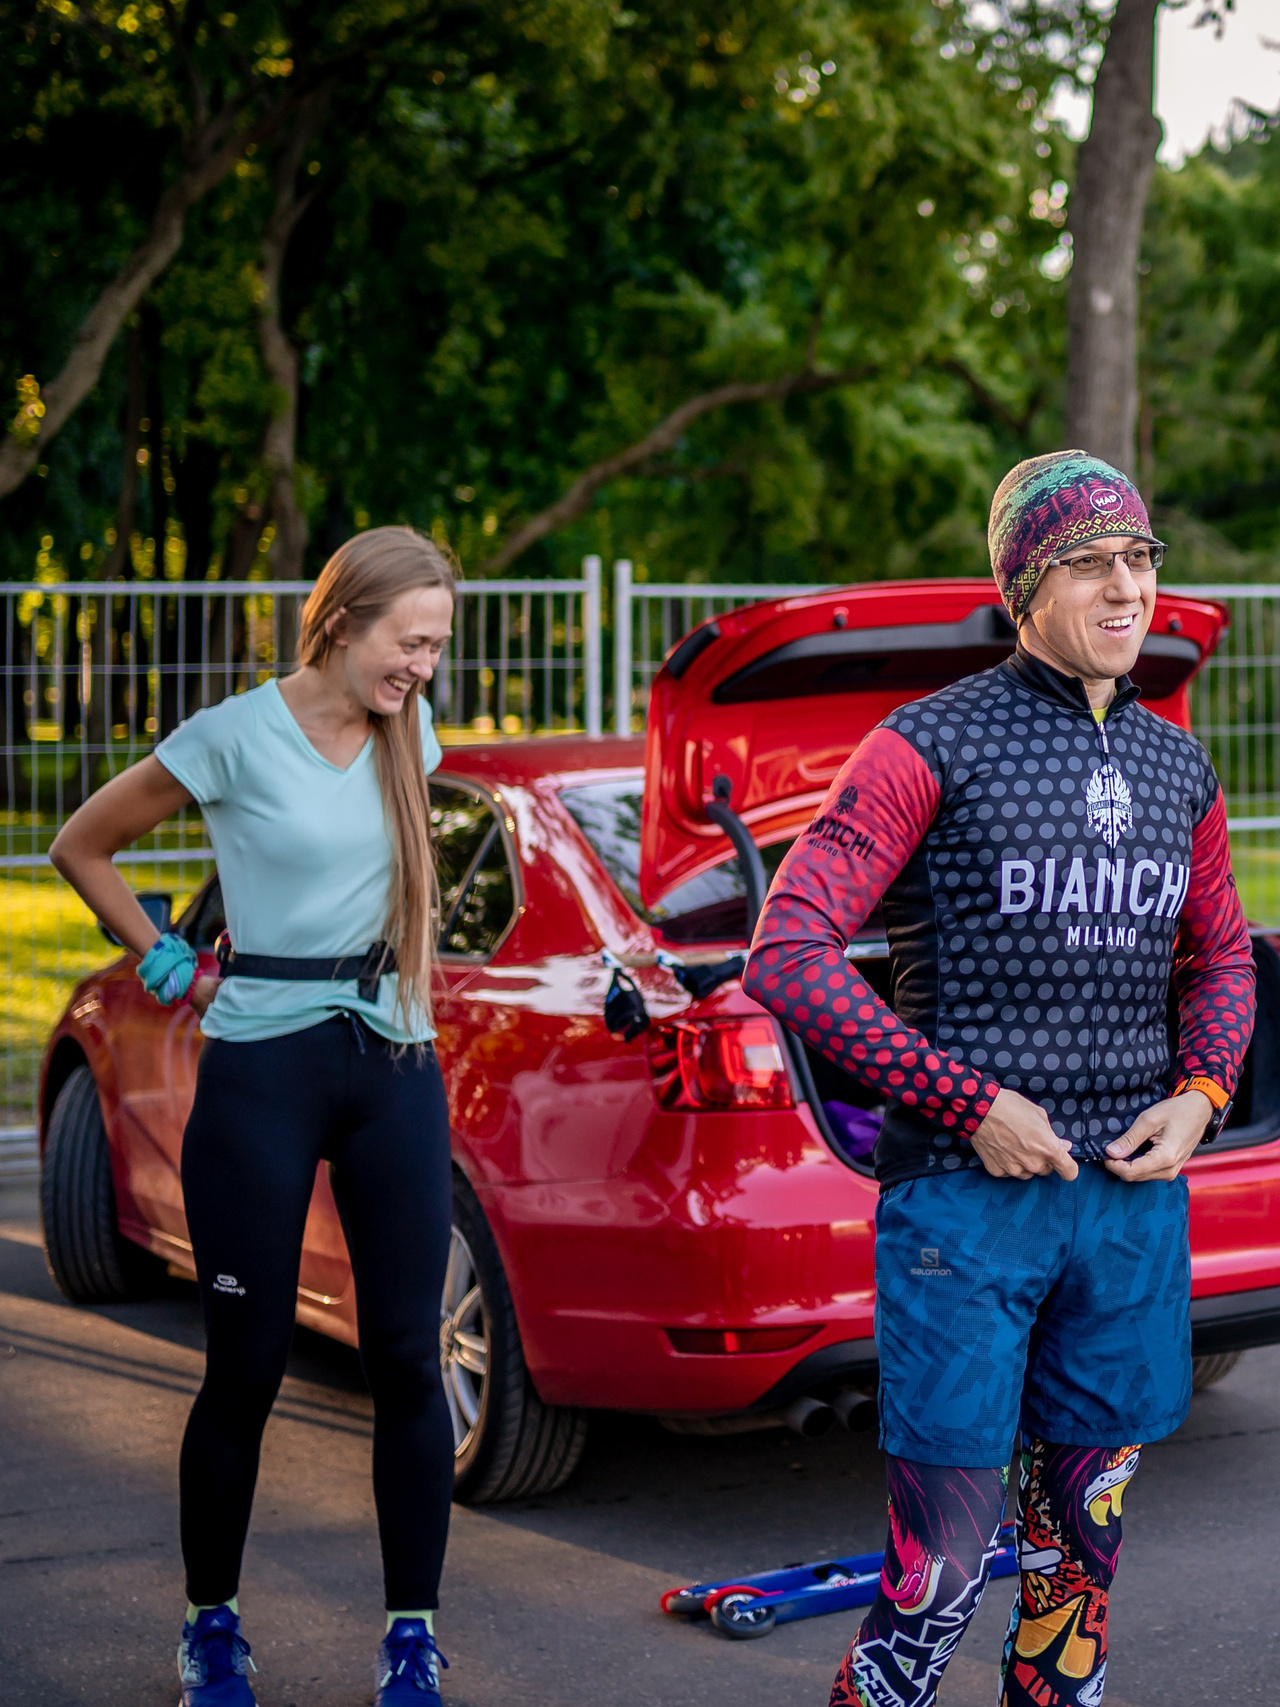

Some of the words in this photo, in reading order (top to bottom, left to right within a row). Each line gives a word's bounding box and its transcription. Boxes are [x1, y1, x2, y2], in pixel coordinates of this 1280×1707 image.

[1095, 494, 1117, 506] HAD
[807, 838, 839, 857] MILANO
[1066, 925, 1137, 948] MILANO
